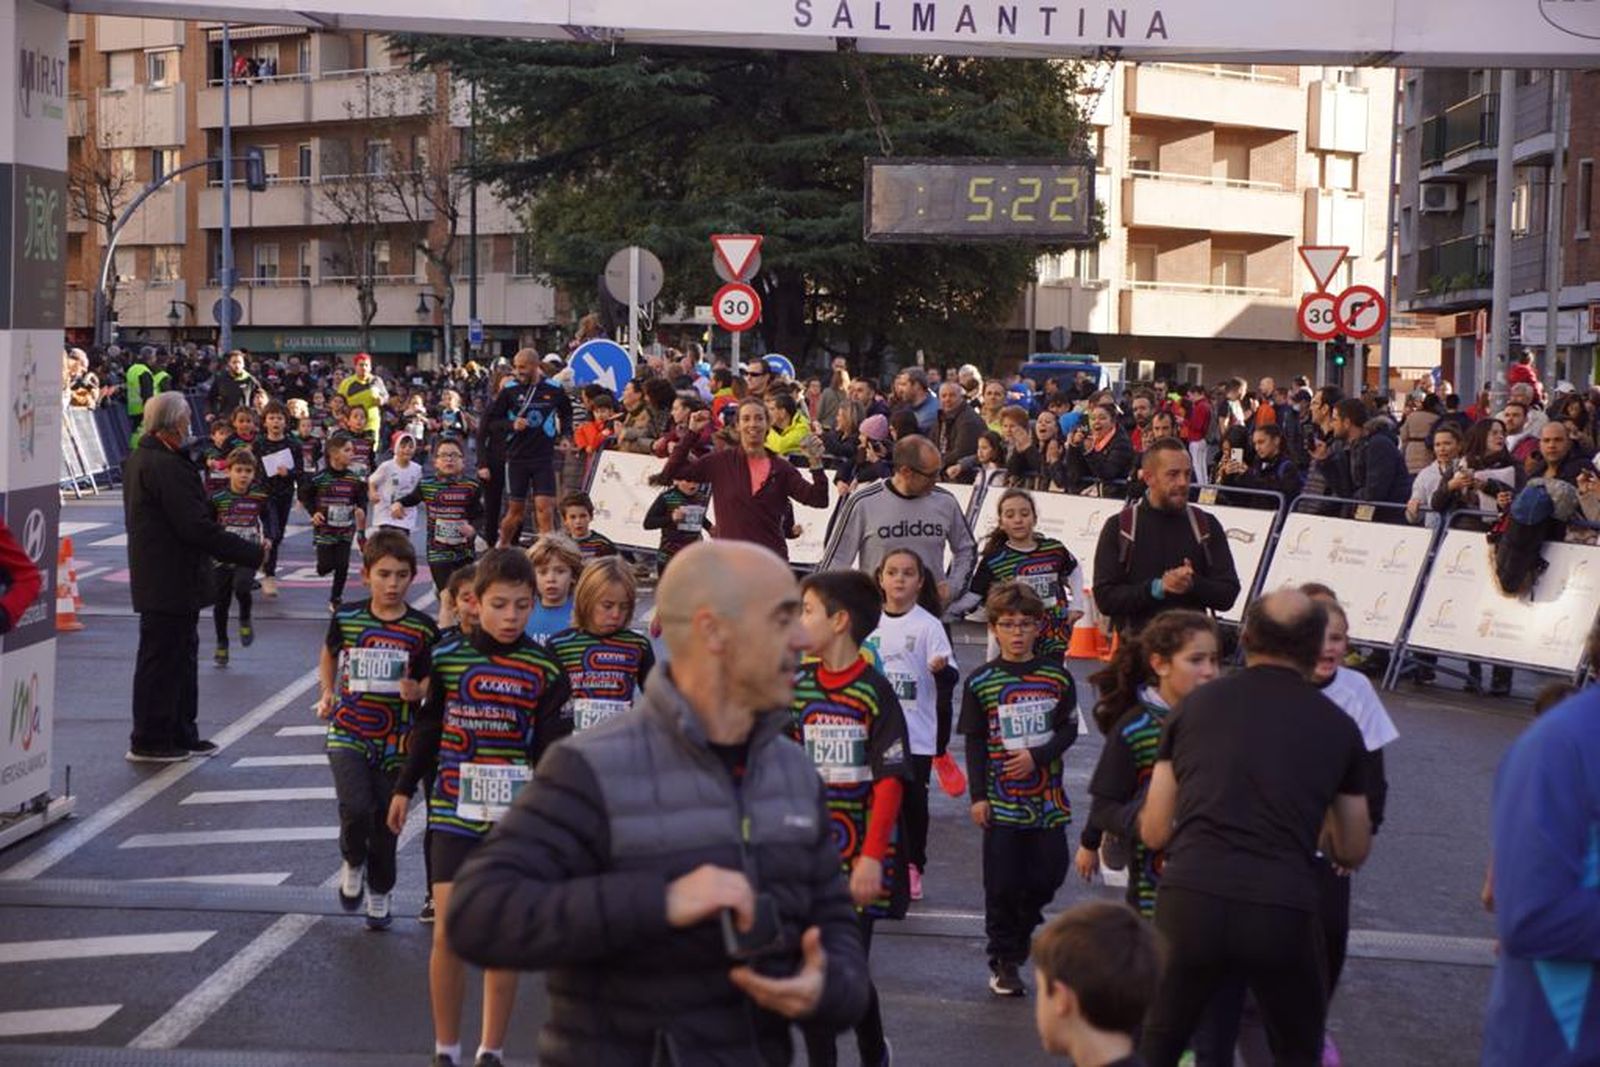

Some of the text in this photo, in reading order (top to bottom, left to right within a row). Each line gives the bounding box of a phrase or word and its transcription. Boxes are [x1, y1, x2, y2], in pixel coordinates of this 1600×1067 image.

[794, 0, 1169, 40] SALMANTINA
[966, 177, 1080, 222] 5:22
[723, 300, 750, 316] 30
[1308, 308, 1334, 325] 30
[877, 520, 943, 539] adidas
[357, 659, 392, 678] 6100
[1011, 712, 1046, 735] 6179
[814, 740, 853, 764] 6201
[471, 779, 512, 803] 6188
